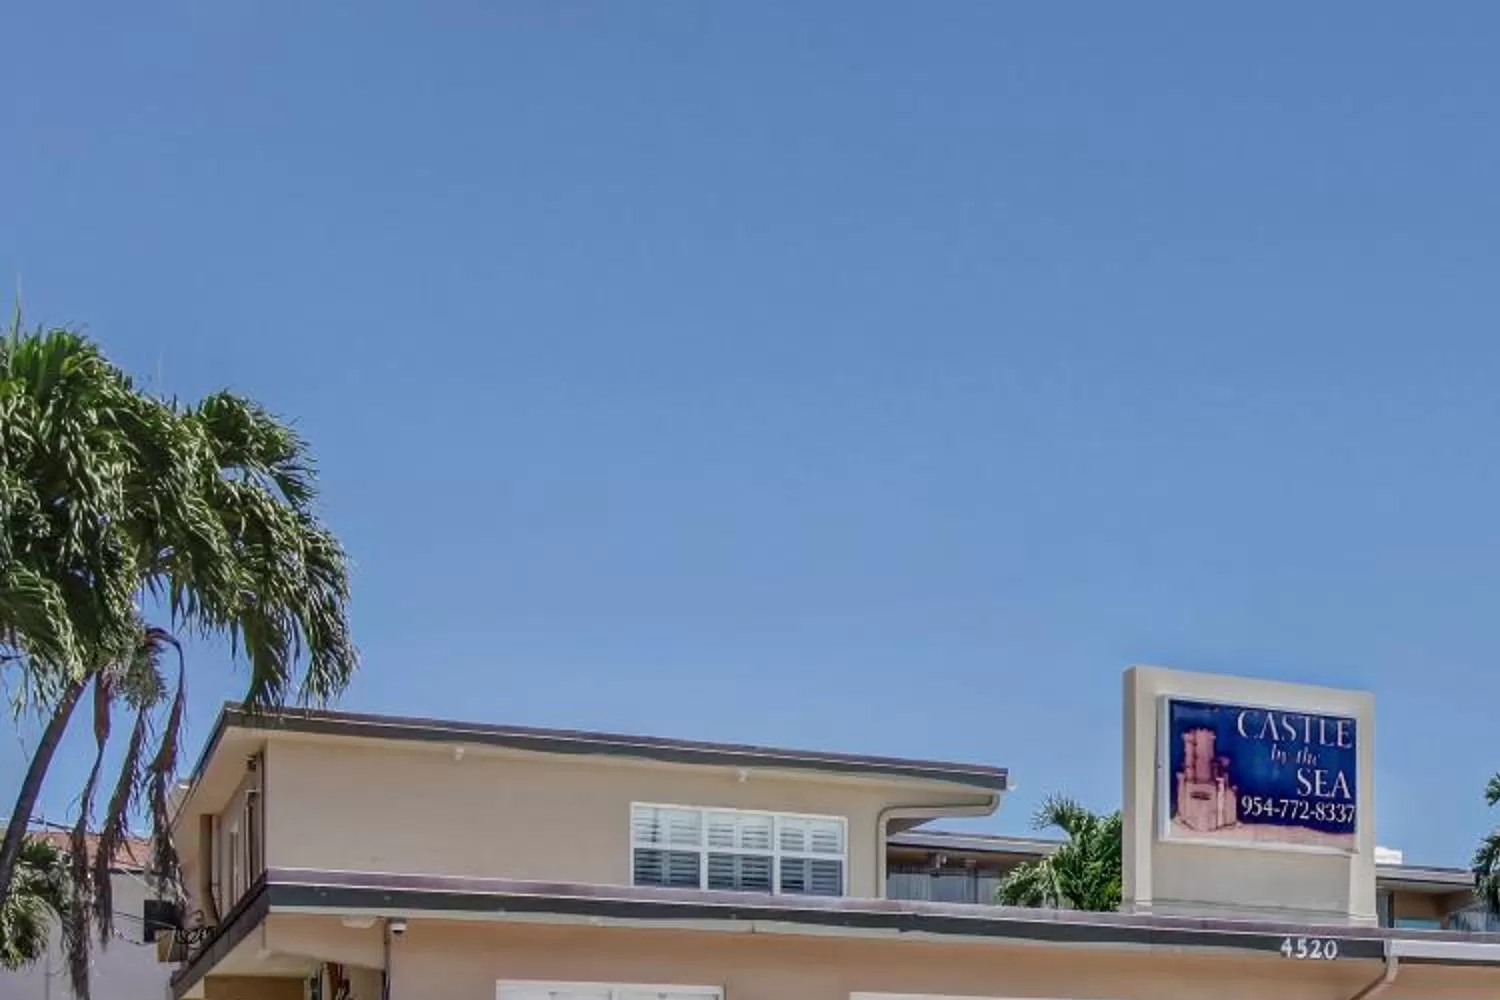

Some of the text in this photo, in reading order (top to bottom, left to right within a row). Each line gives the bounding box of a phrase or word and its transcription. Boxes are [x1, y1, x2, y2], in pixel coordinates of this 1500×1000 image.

[1237, 709, 1353, 749] CASTLE
[1270, 743, 1321, 767] by the
[1296, 767, 1351, 799] SEA
[1240, 794, 1356, 823] 954-772-8337
[1280, 936, 1339, 960] 4520
